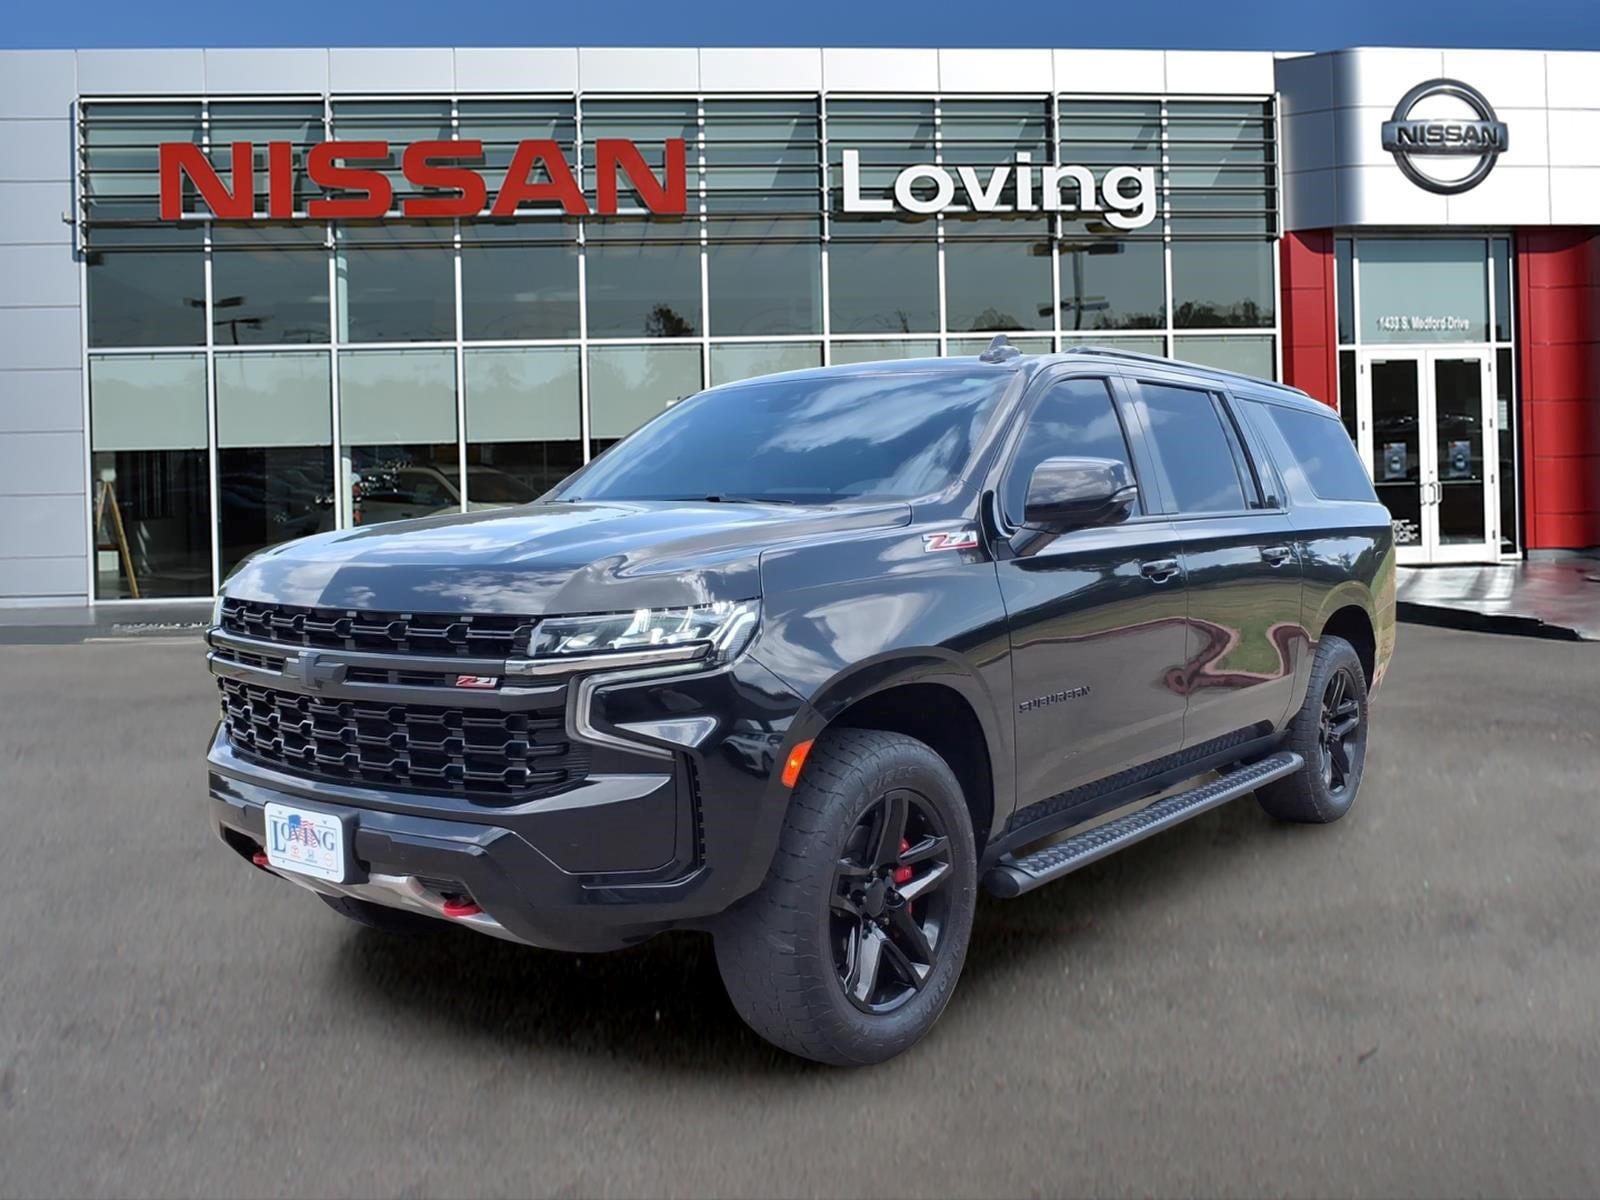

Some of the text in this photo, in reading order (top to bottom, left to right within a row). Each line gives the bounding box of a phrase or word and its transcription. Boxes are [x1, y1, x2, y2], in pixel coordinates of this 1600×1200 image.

[1397, 125, 1498, 145] NISSAN
[159, 138, 687, 220] NISSAN
[842, 149, 1157, 229] Loving
[1401, 316, 1410, 330] S.
[1447, 316, 1470, 330] Drive
[922, 531, 978, 552] Z71
[1018, 686, 1091, 713] SUBURBAN
[271, 820, 335, 853] LOVING
